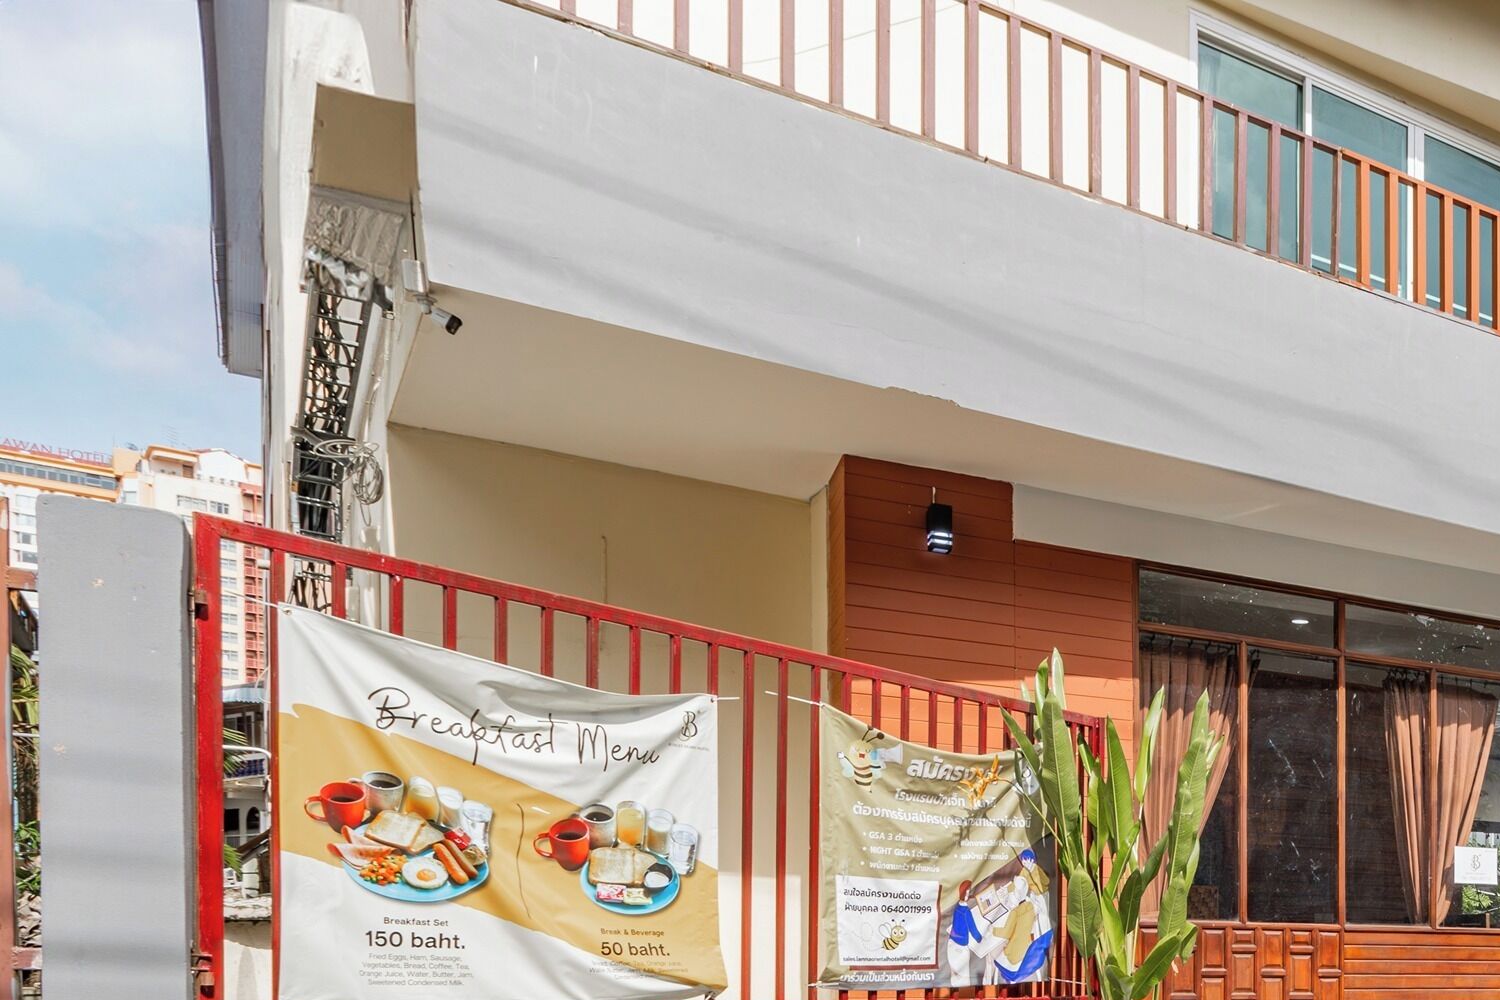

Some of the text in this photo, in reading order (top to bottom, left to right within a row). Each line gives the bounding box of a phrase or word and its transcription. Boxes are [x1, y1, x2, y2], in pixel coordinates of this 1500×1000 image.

[58, 448, 106, 463] HOTEL
[368, 687, 660, 771] Breakfast Menu
[907, 755, 1003, 784] สมัครง
[881, 905, 932, 914] 0640011999
[383, 917, 448, 927] Breakfast Set
[365, 930, 465, 949] 150 baht.
[630, 929, 665, 937] Beverage
[601, 941, 670, 957] 50 baht.
